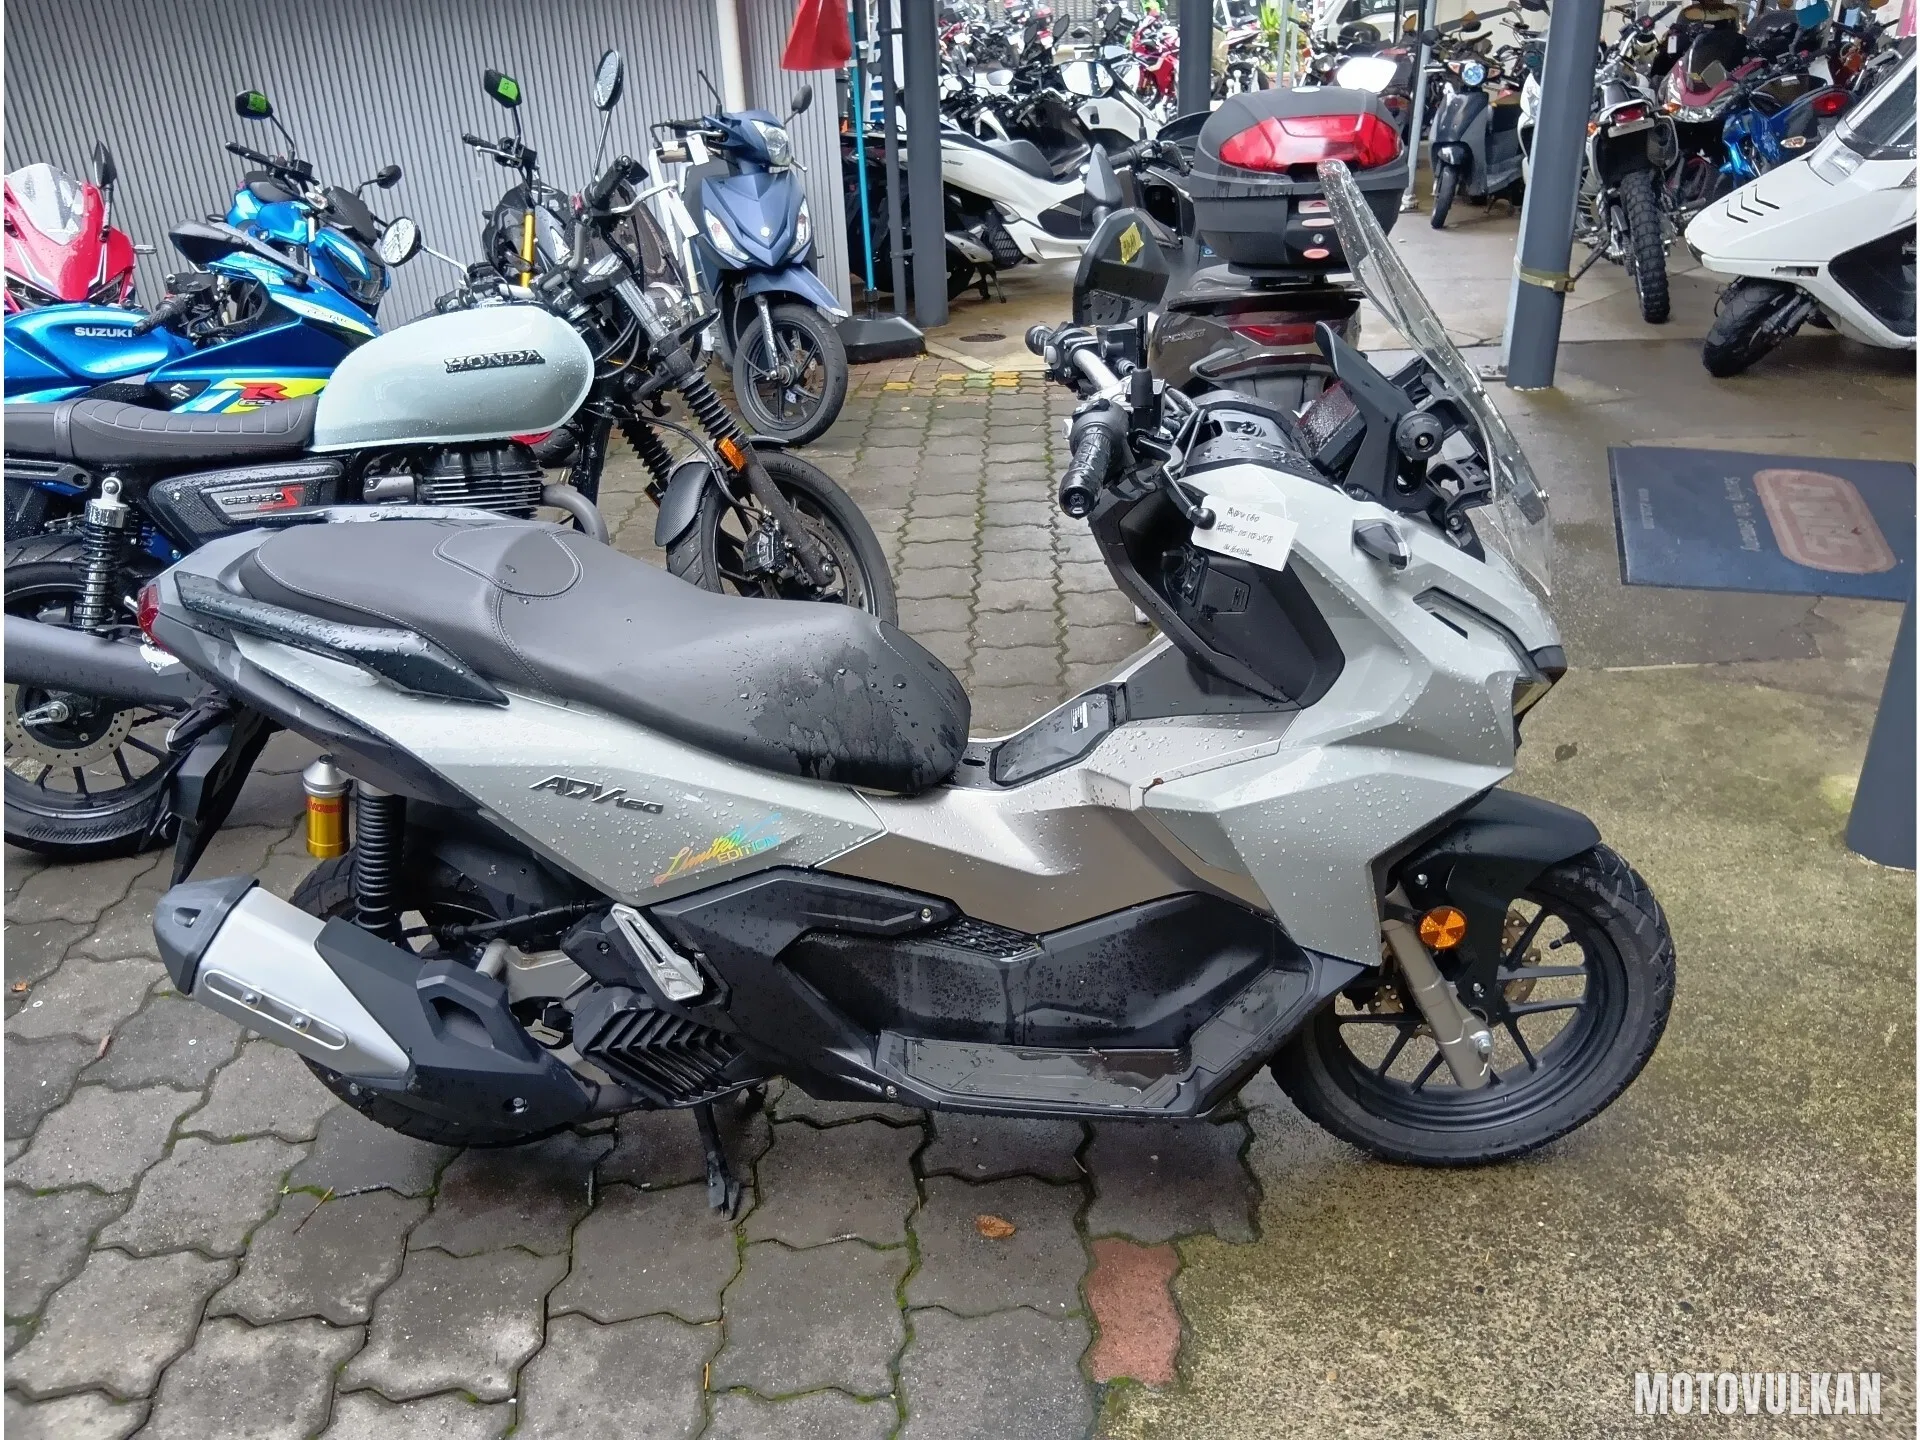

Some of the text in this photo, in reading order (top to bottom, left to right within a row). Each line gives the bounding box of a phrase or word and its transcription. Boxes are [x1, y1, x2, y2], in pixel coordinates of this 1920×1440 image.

[74, 326, 133, 338] SUZUKI
[443, 349, 545, 374] HONDA
[653, 816, 770, 887] Limited
[717, 834, 781, 863] EDITION
